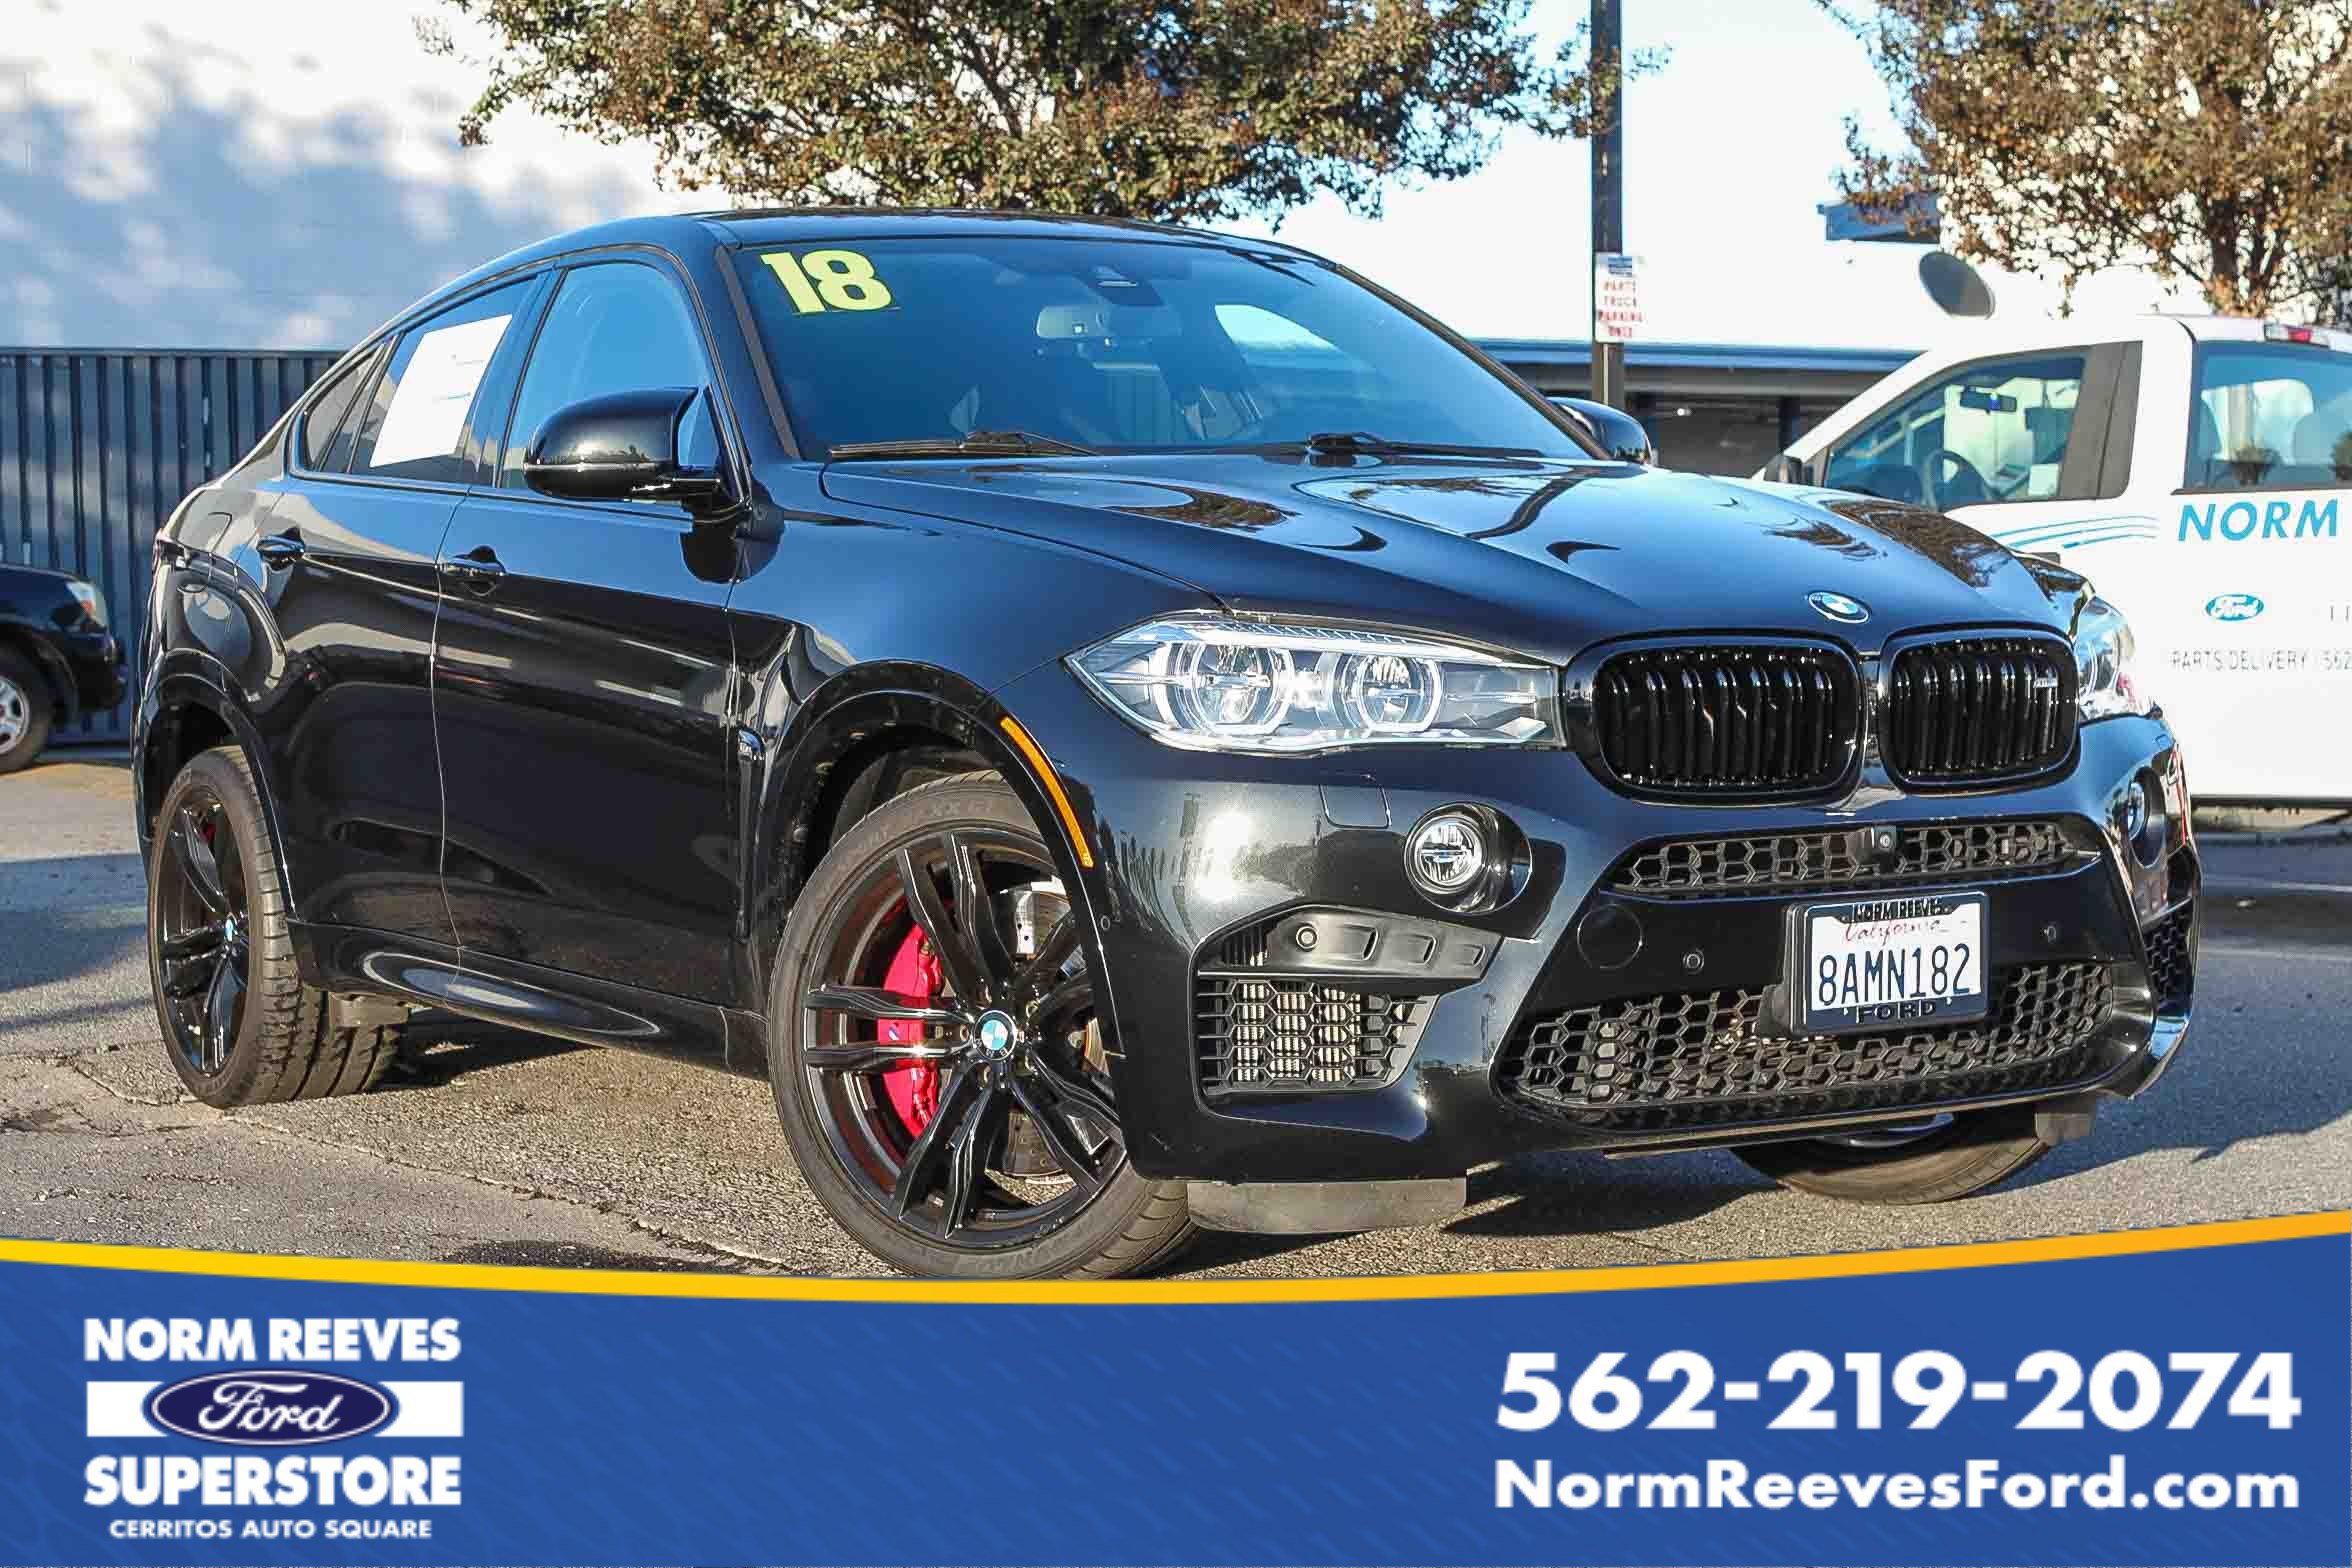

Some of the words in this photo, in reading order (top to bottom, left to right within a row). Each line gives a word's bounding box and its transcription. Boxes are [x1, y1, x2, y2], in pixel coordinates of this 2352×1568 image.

[759, 249, 893, 314] 18
[2177, 498, 2339, 542] NORM
[2171, 649, 2225, 671] PARTS
[2229, 648, 2307, 671] DELIVERY
[1818, 943, 1971, 1006] 8AMN182
[1855, 1001, 1937, 1024] FORD
